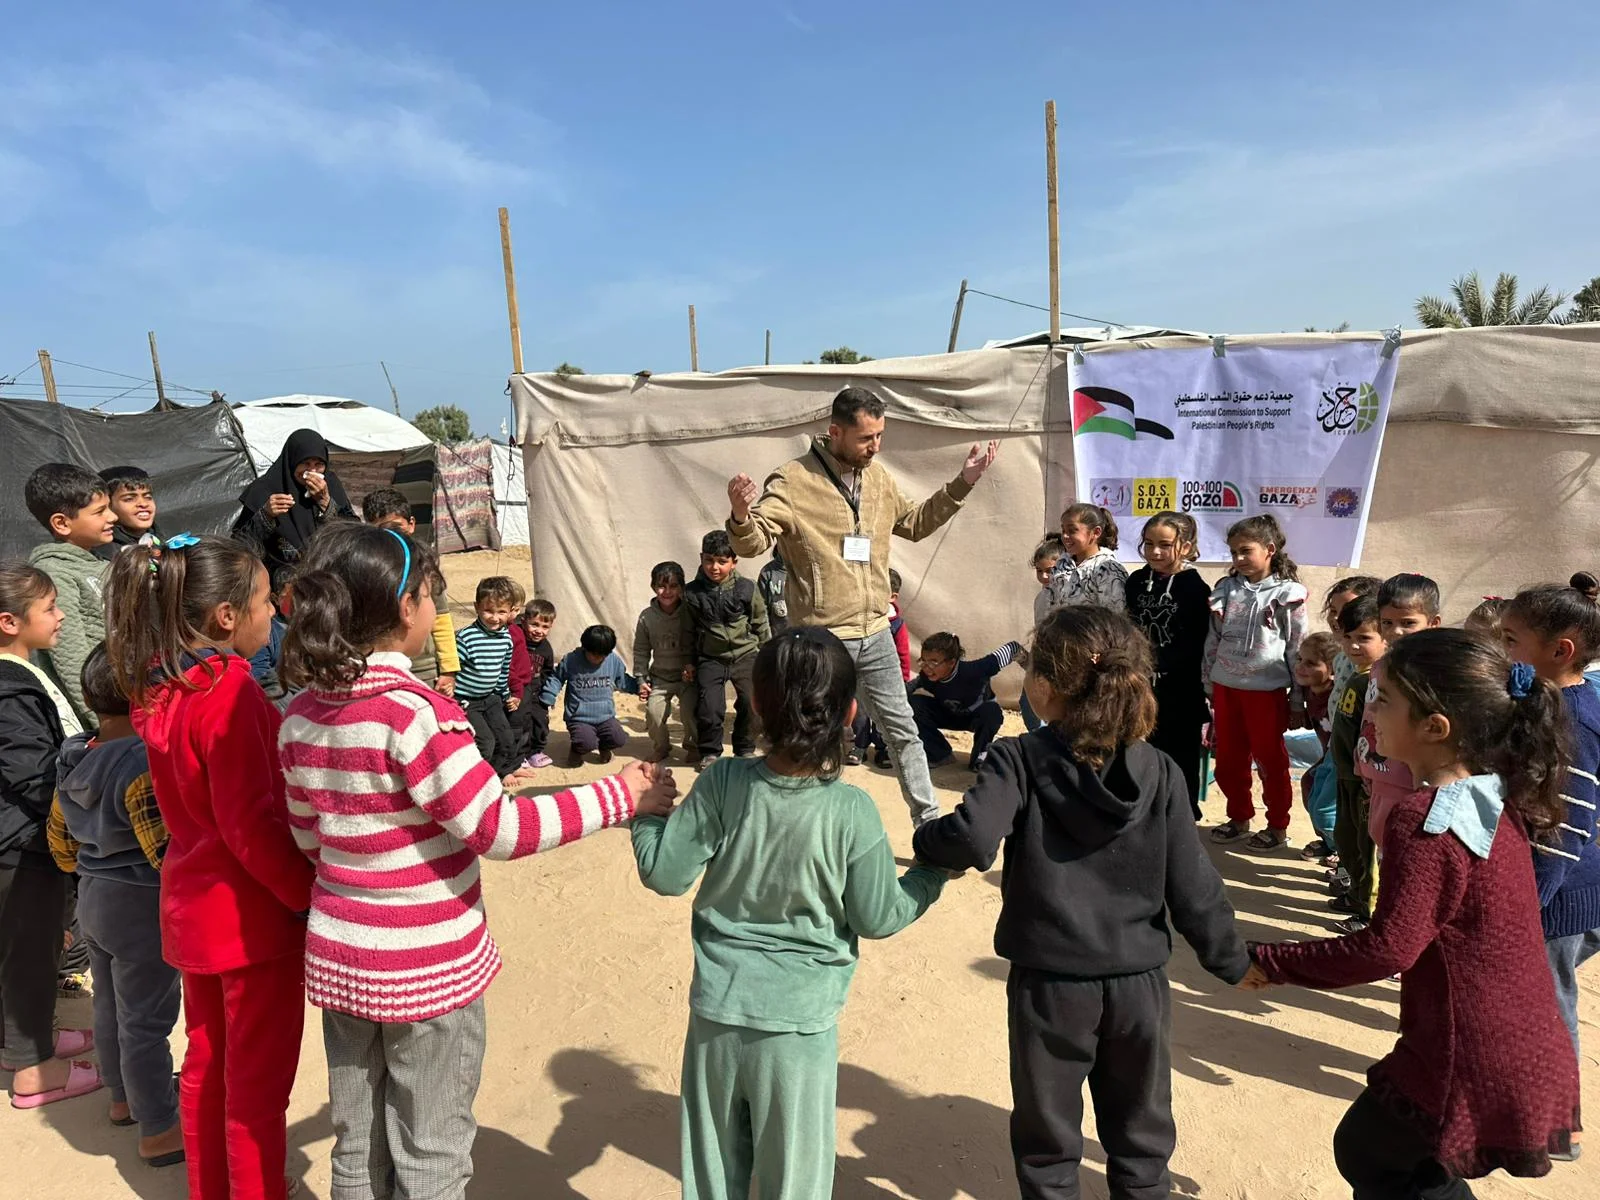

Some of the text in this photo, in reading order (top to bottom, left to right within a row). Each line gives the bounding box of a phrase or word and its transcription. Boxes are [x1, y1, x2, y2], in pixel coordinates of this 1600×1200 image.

[1209, 391, 1232, 404] الشعب
[1232, 391, 1253, 404] حقوق
[1254, 391, 1268, 404] دعم
[1270, 391, 1294, 404] جمعية
[1177, 407, 1291, 418] International Commission to Support
[1191, 420, 1275, 431] Palestinian People's Rights
[1137, 484, 1170, 497] S.O.S.
[1260, 486, 1317, 494] EMERGENZA
[1137, 498, 1170, 509] GAZA
[1181, 493, 1222, 512] gaza
[1259, 493, 1299, 504] GAZA
[575, 675, 611, 689] SKATE
